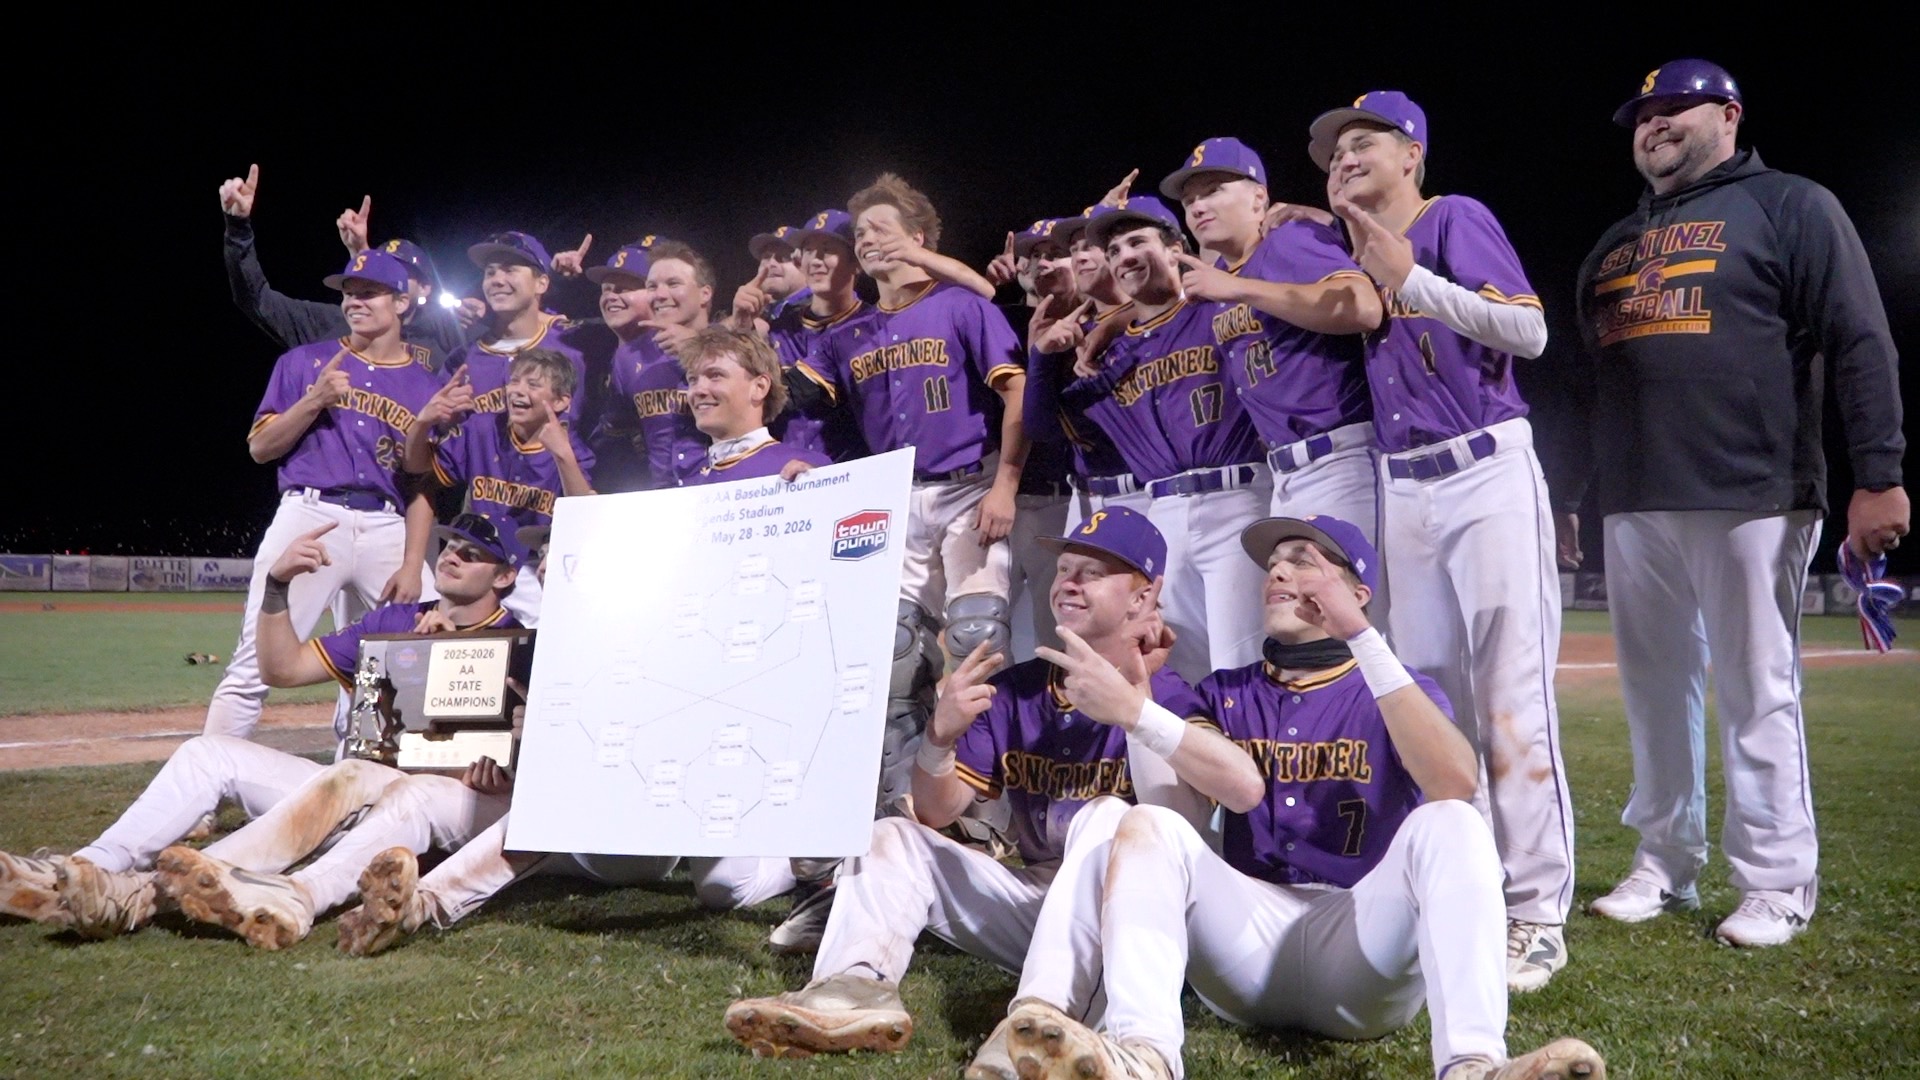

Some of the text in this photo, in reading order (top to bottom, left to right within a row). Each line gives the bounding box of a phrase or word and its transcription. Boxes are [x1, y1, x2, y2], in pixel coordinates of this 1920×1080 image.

[1642, 68, 1661, 95] S
[1191, 145, 1206, 168] S
[815, 213, 829, 229] S
[641, 235, 657, 248] S
[775, 226, 788, 238] S
[386, 240, 401, 253] S
[1599, 221, 1727, 277] SENTINEL
[352, 255, 367, 272] S
[614, 251, 628, 268] S
[850, 338, 949, 384] SENTINEL
[1244, 340, 1277, 388] 14
[924, 375, 951, 414] 11
[1190, 382, 1223, 427] 17
[734, 481, 782, 501] Baseball
[784, 472, 850, 494] Tournament
[738, 504, 784, 521] Stadium
[711, 531, 736, 546] May
[738, 527, 753, 540] 28
[763, 524, 780, 538] 30,
[784, 519, 812, 534] 2026
[838, 519, 887, 537] town
[1081, 511, 1108, 535] S
[837, 533, 885, 553] pump
[444, 649, 495, 660] 2025-2026
[459, 665, 475, 675] AA
[449, 681, 482, 691] STATE
[431, 697, 496, 708] CHAMPIONS
[1338, 798, 1366, 856] 7
